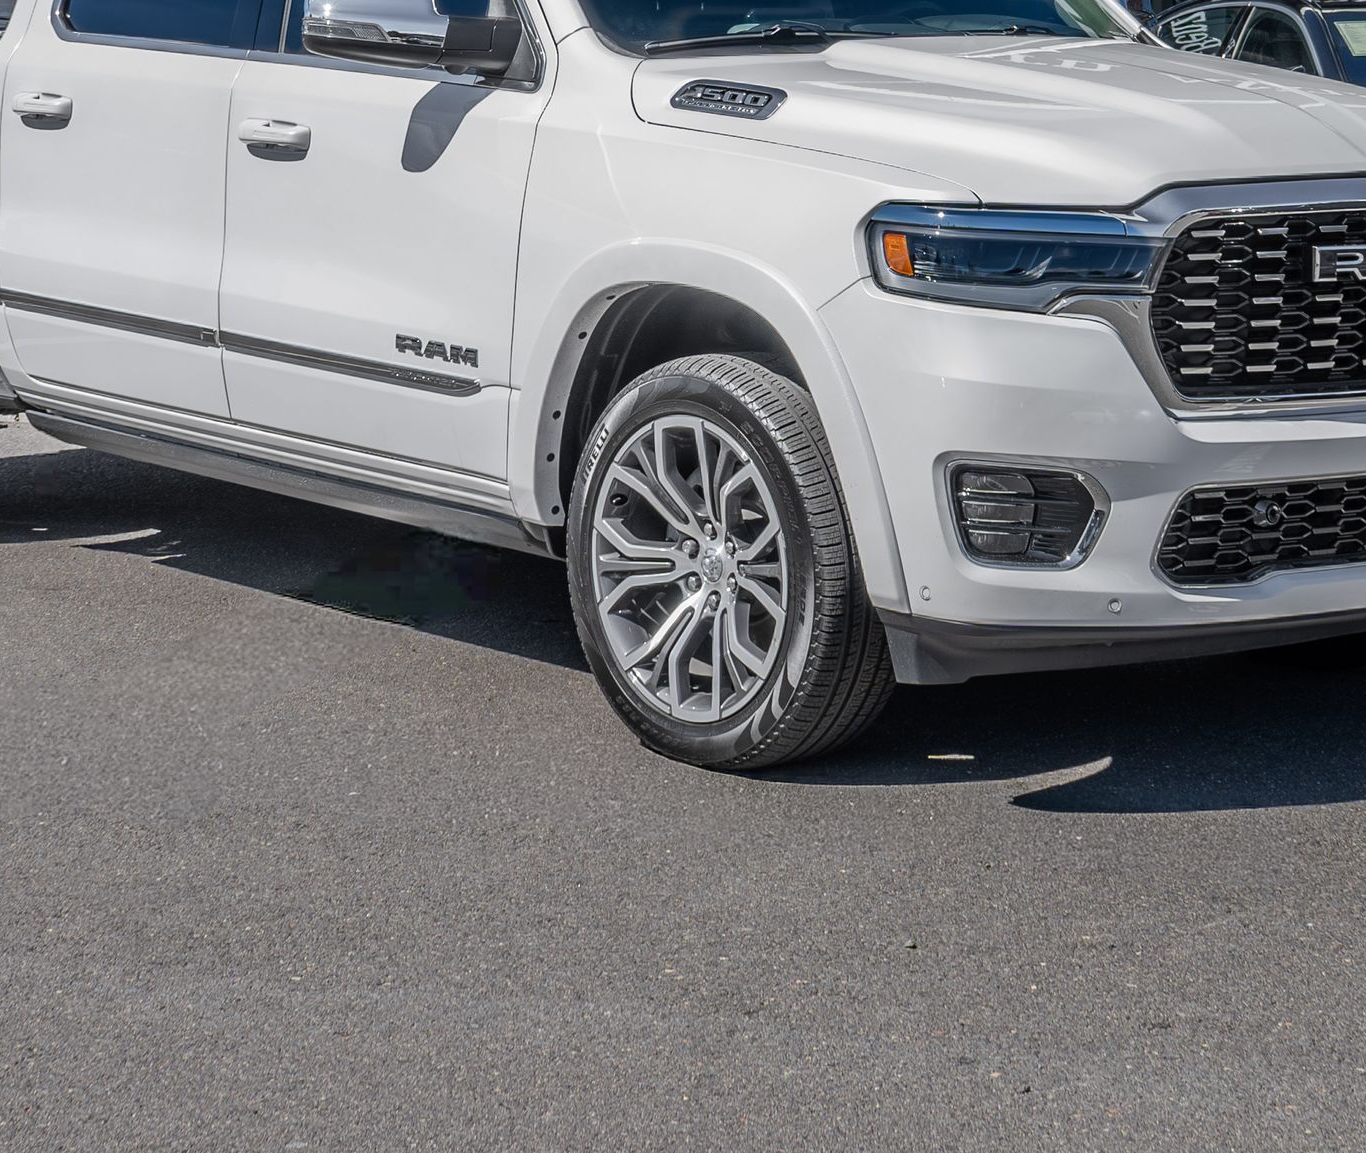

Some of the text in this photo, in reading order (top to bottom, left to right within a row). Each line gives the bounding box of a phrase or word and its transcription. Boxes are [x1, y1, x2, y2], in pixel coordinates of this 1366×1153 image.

[685, 85, 769, 108] 1500
[395, 333, 479, 368] RAM
[579, 422, 610, 485] PIRELLI
